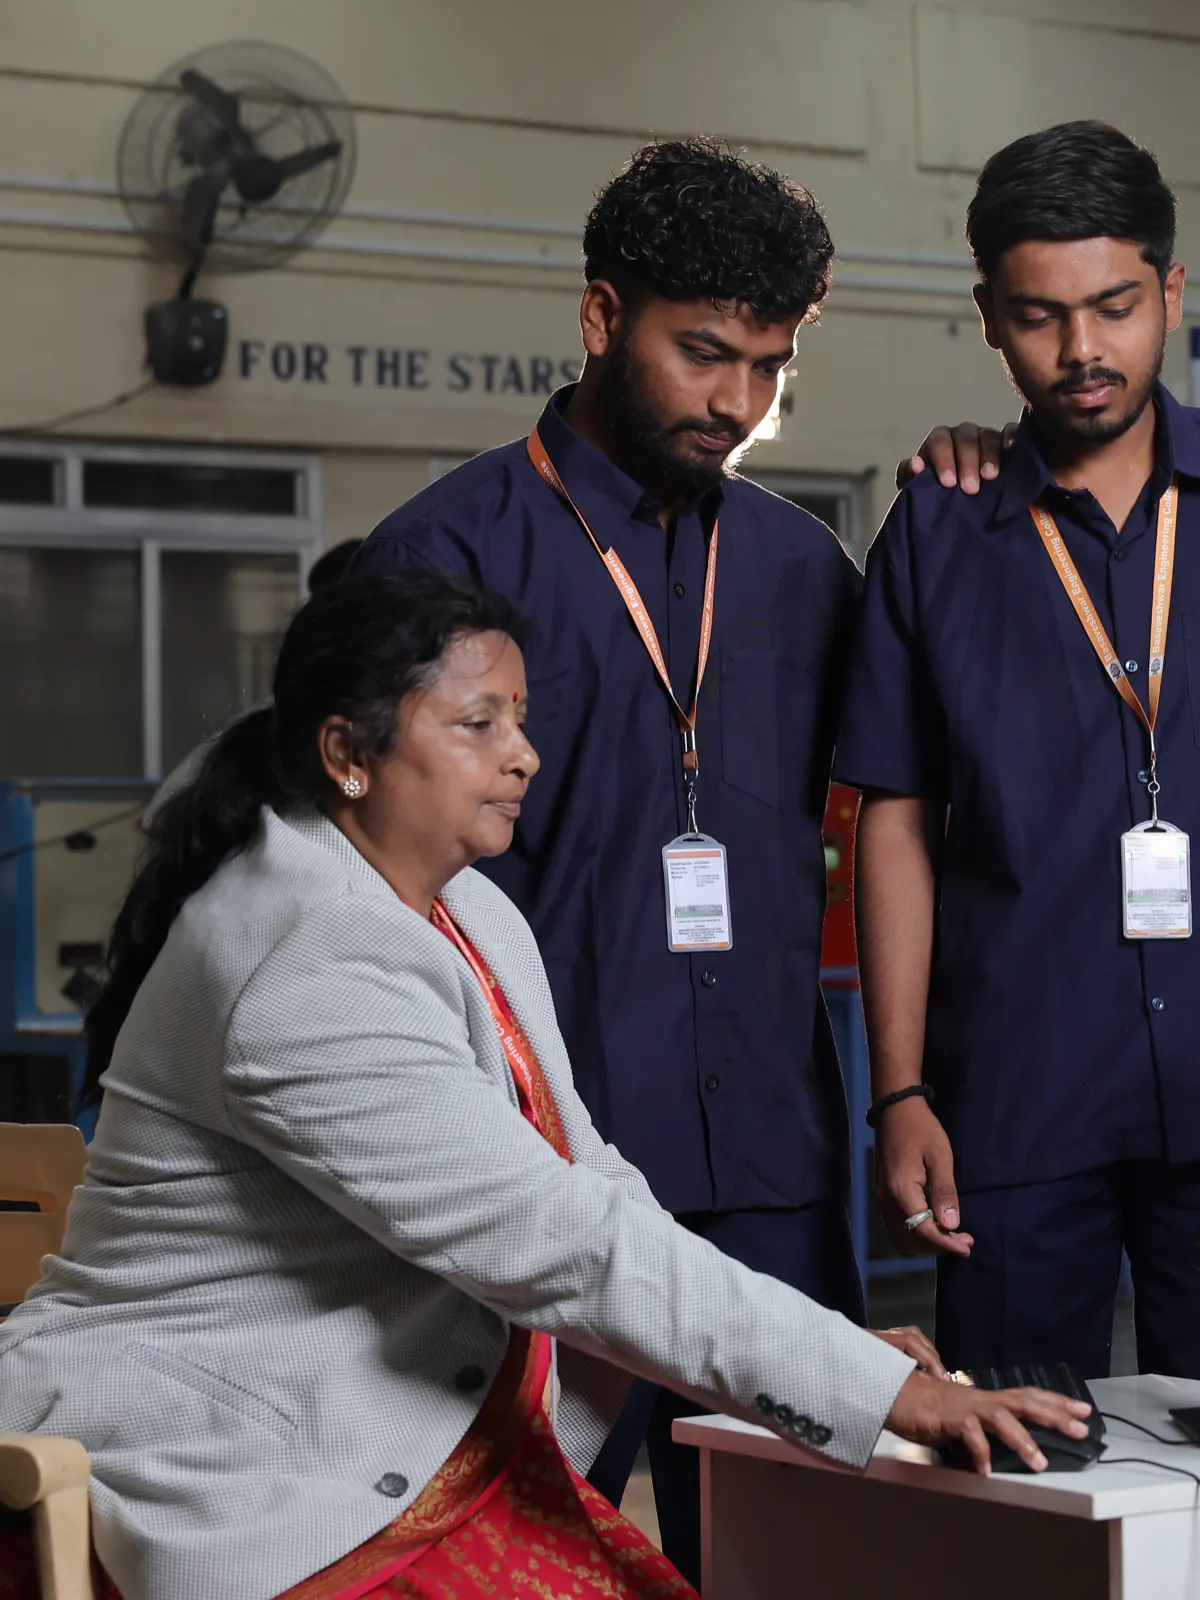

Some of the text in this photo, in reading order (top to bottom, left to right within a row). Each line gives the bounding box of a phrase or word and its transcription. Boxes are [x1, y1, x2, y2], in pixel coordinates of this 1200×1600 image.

[239, 341, 329, 384] FOR
[347, 346, 430, 390] THE
[1038, 506, 1112, 662] Basaveshwar Engineering Colle
[1152, 485, 1174, 653] Basaveshwar Engineering Colle
